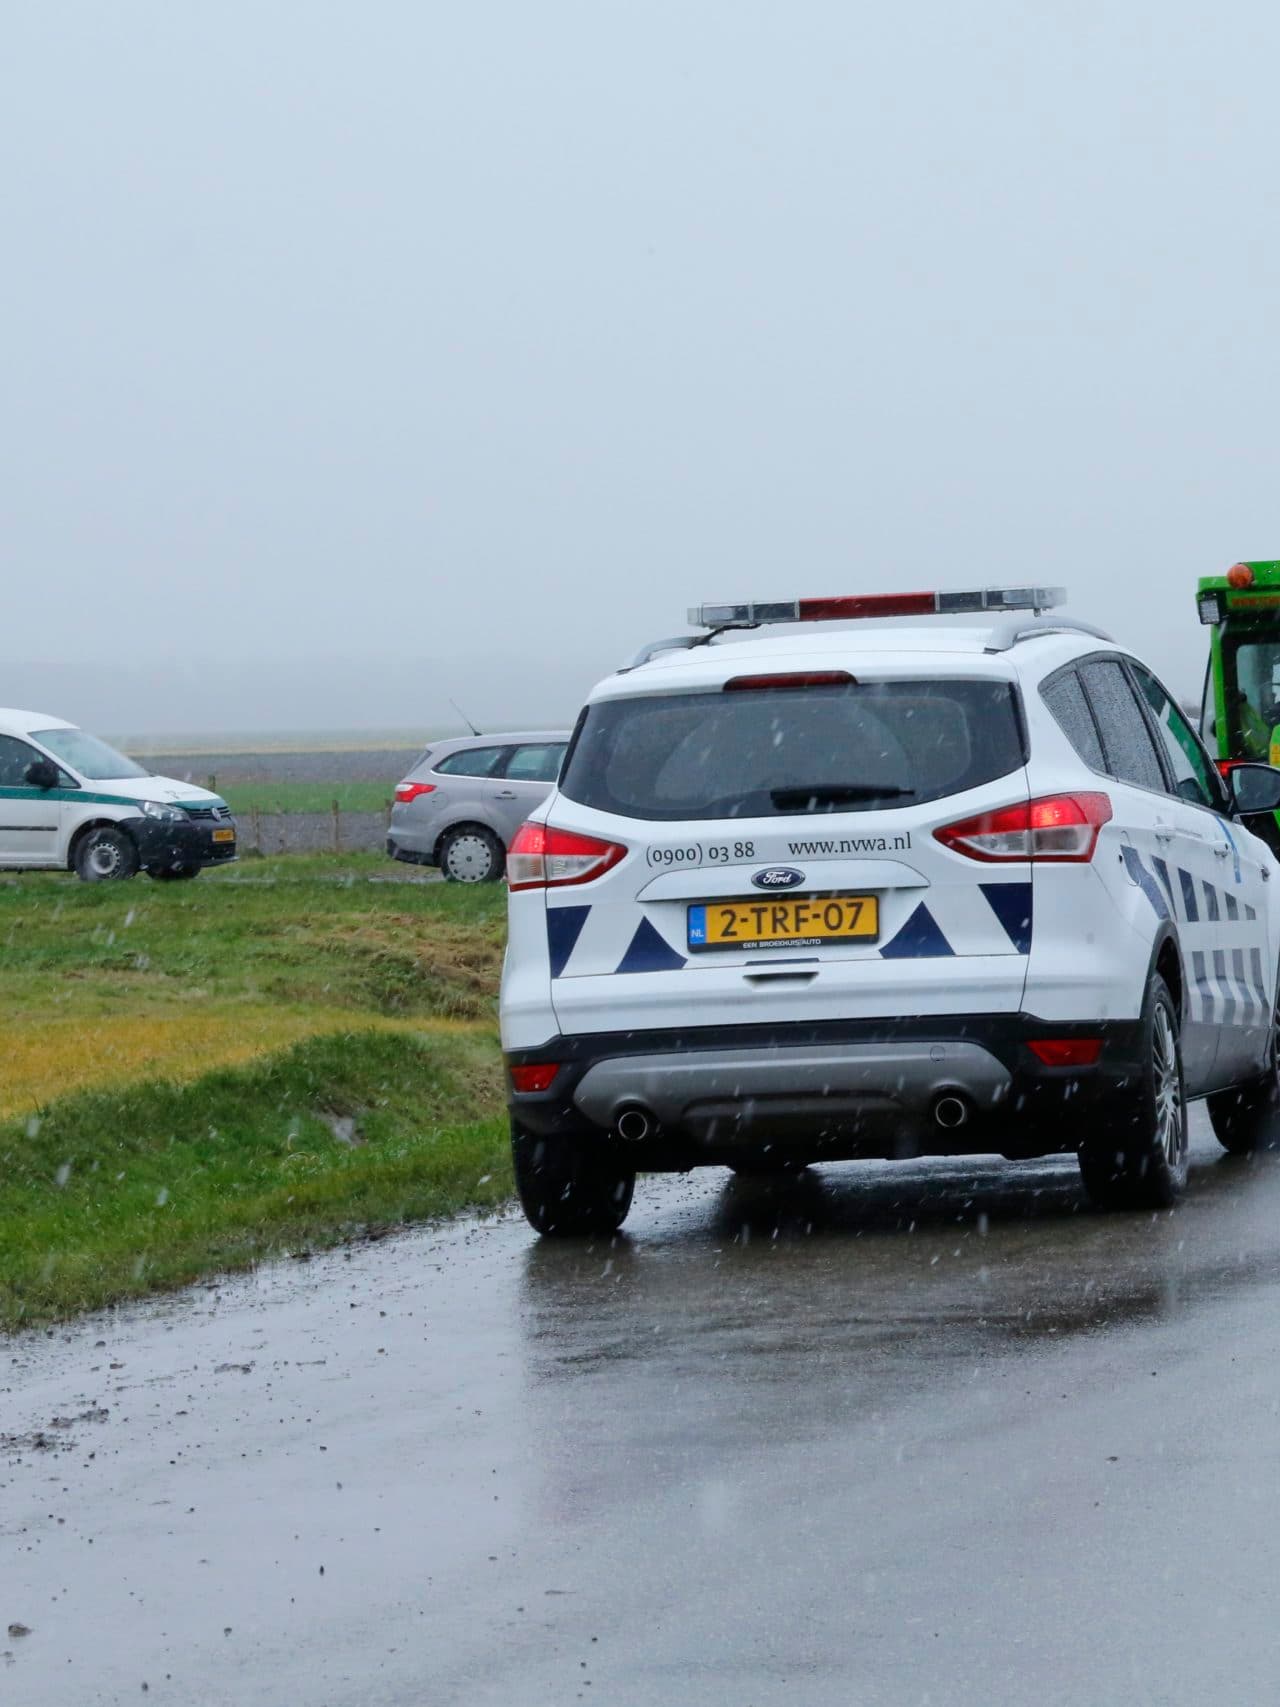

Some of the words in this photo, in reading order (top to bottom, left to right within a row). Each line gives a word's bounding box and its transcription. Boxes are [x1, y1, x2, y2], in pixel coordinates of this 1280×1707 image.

[646, 843, 703, 868] (0900)
[708, 847, 729, 862] 03
[734, 841, 755, 858] 88
[788, 832, 912, 855] www.nvwa.nl
[762, 871, 793, 884] Ford
[720, 902, 864, 937] 2-TRF-07
[691, 929, 704, 938] NL
